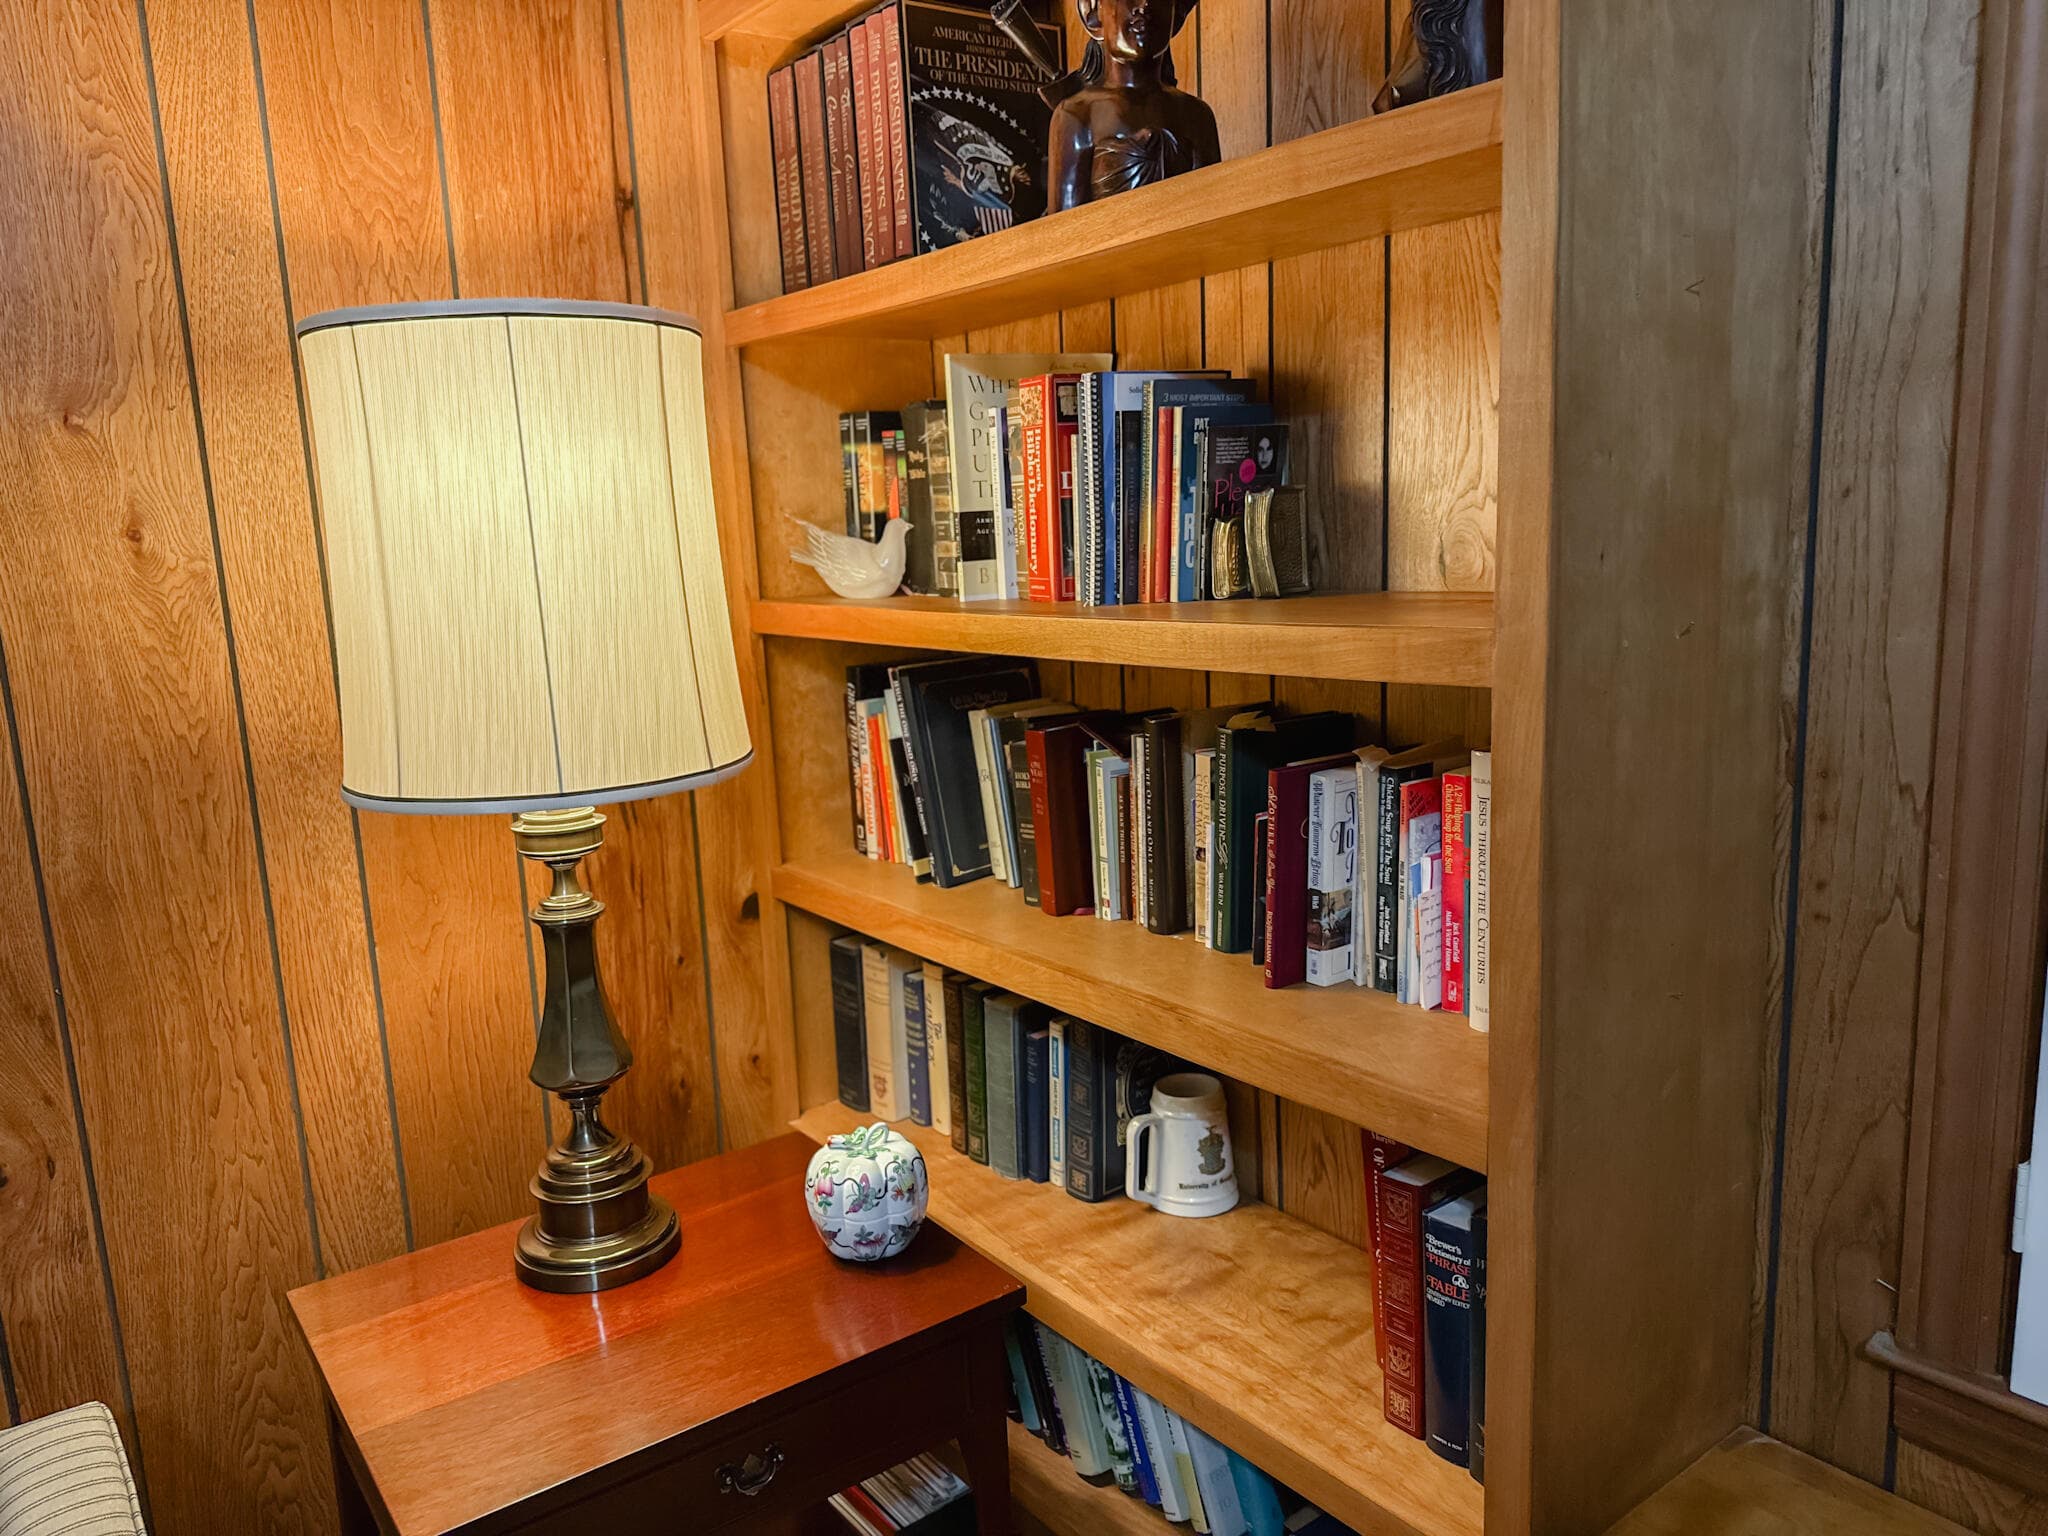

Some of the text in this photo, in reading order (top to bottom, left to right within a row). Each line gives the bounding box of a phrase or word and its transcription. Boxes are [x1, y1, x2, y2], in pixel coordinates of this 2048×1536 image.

[932, 26, 1018, 49] AMERICAN HERIT
[915, 46, 953, 69] THE
[930, 69, 1040, 94] OF THE UNITED STATE
[870, 69, 887, 211] PRESIDENTS
[888, 60, 905, 204] PRESIDENTS
[855, 74, 876, 265] THE PRESIDENCY
[790, 154, 801, 222] WORLD
[794, 226, 805, 266] WAR
[1169, 393, 1188, 401] MOST
[1189, 393, 1225, 401] IMPORTANT
[1194, 418, 1210, 430] PAT
[1026, 429, 1037, 477] Bible
[1034, 428, 1044, 493] Harper's
[1016, 488, 1026, 545] EVERYONE
[1028, 478, 1039, 575] Dictionary
[897, 703, 906, 719] THE
[900, 720, 910, 738] ONE
[905, 741, 914, 759] AND
[908, 761, 919, 783] ONLY
[1218, 753, 1226, 796] PURPOSE
[1386, 777, 1395, 810] Chicken
[863, 790, 875, 835] GRAHAM
[1195, 774, 1203, 845] CHRISTMAS
[1218, 799, 1226, 838] DRIVEN
[1384, 811, 1393, 833] Soup
[1453, 803, 1462, 832] Helping
[1311, 820, 1322, 857] Tomorrow
[1443, 784, 1454, 874] Chicken Soup for the Soul
[1384, 849, 1392, 864] The
[1310, 858, 1321, 887] Brings
[1383, 866, 1392, 885] Soul
[1477, 795, 1490, 984] JESUS THROUGH THE CENTURIES
[1453, 922, 1461, 963] Jack Canfield
[1425, 1233, 1462, 1255] Brewer's
[1425, 1243, 1463, 1264] Dictionary
[1426, 1252, 1471, 1276] PHRASE
[1427, 1275, 1470, 1302] FABLE
[1452, 1274, 1469, 1289] &
[1116, 1375, 1142, 1465] eorgia Almanac
